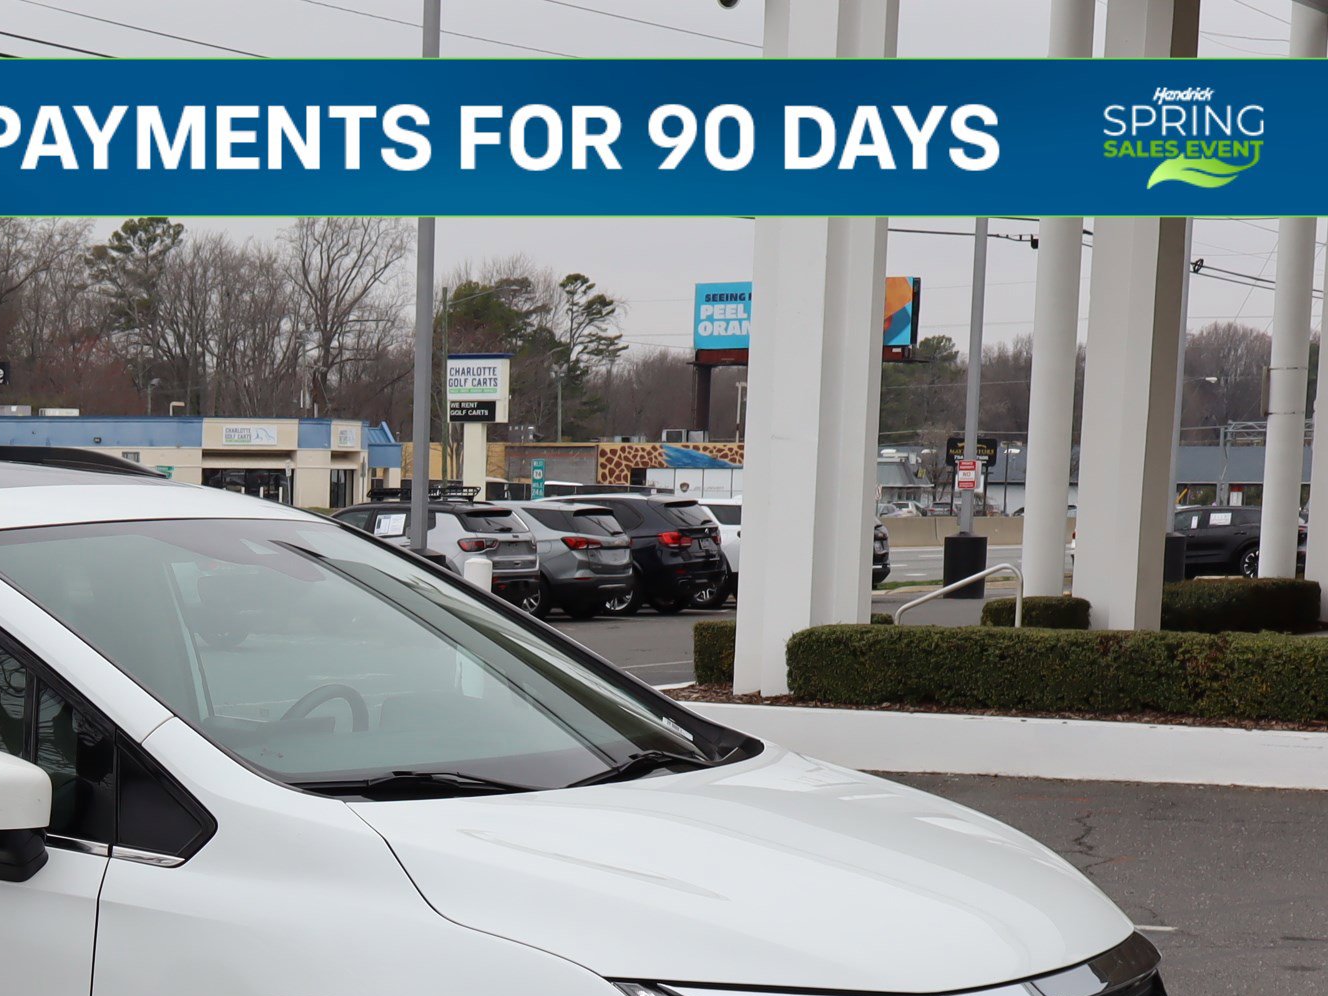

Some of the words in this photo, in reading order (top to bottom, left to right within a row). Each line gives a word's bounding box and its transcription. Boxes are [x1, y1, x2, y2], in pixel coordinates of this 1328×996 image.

[705, 293, 745, 302] SEEING
[700, 304, 747, 320] PEEL
[449, 366, 498, 377] CHARLOTTE
[448, 378, 468, 387] GOLF
[471, 378, 498, 387] CARTS
